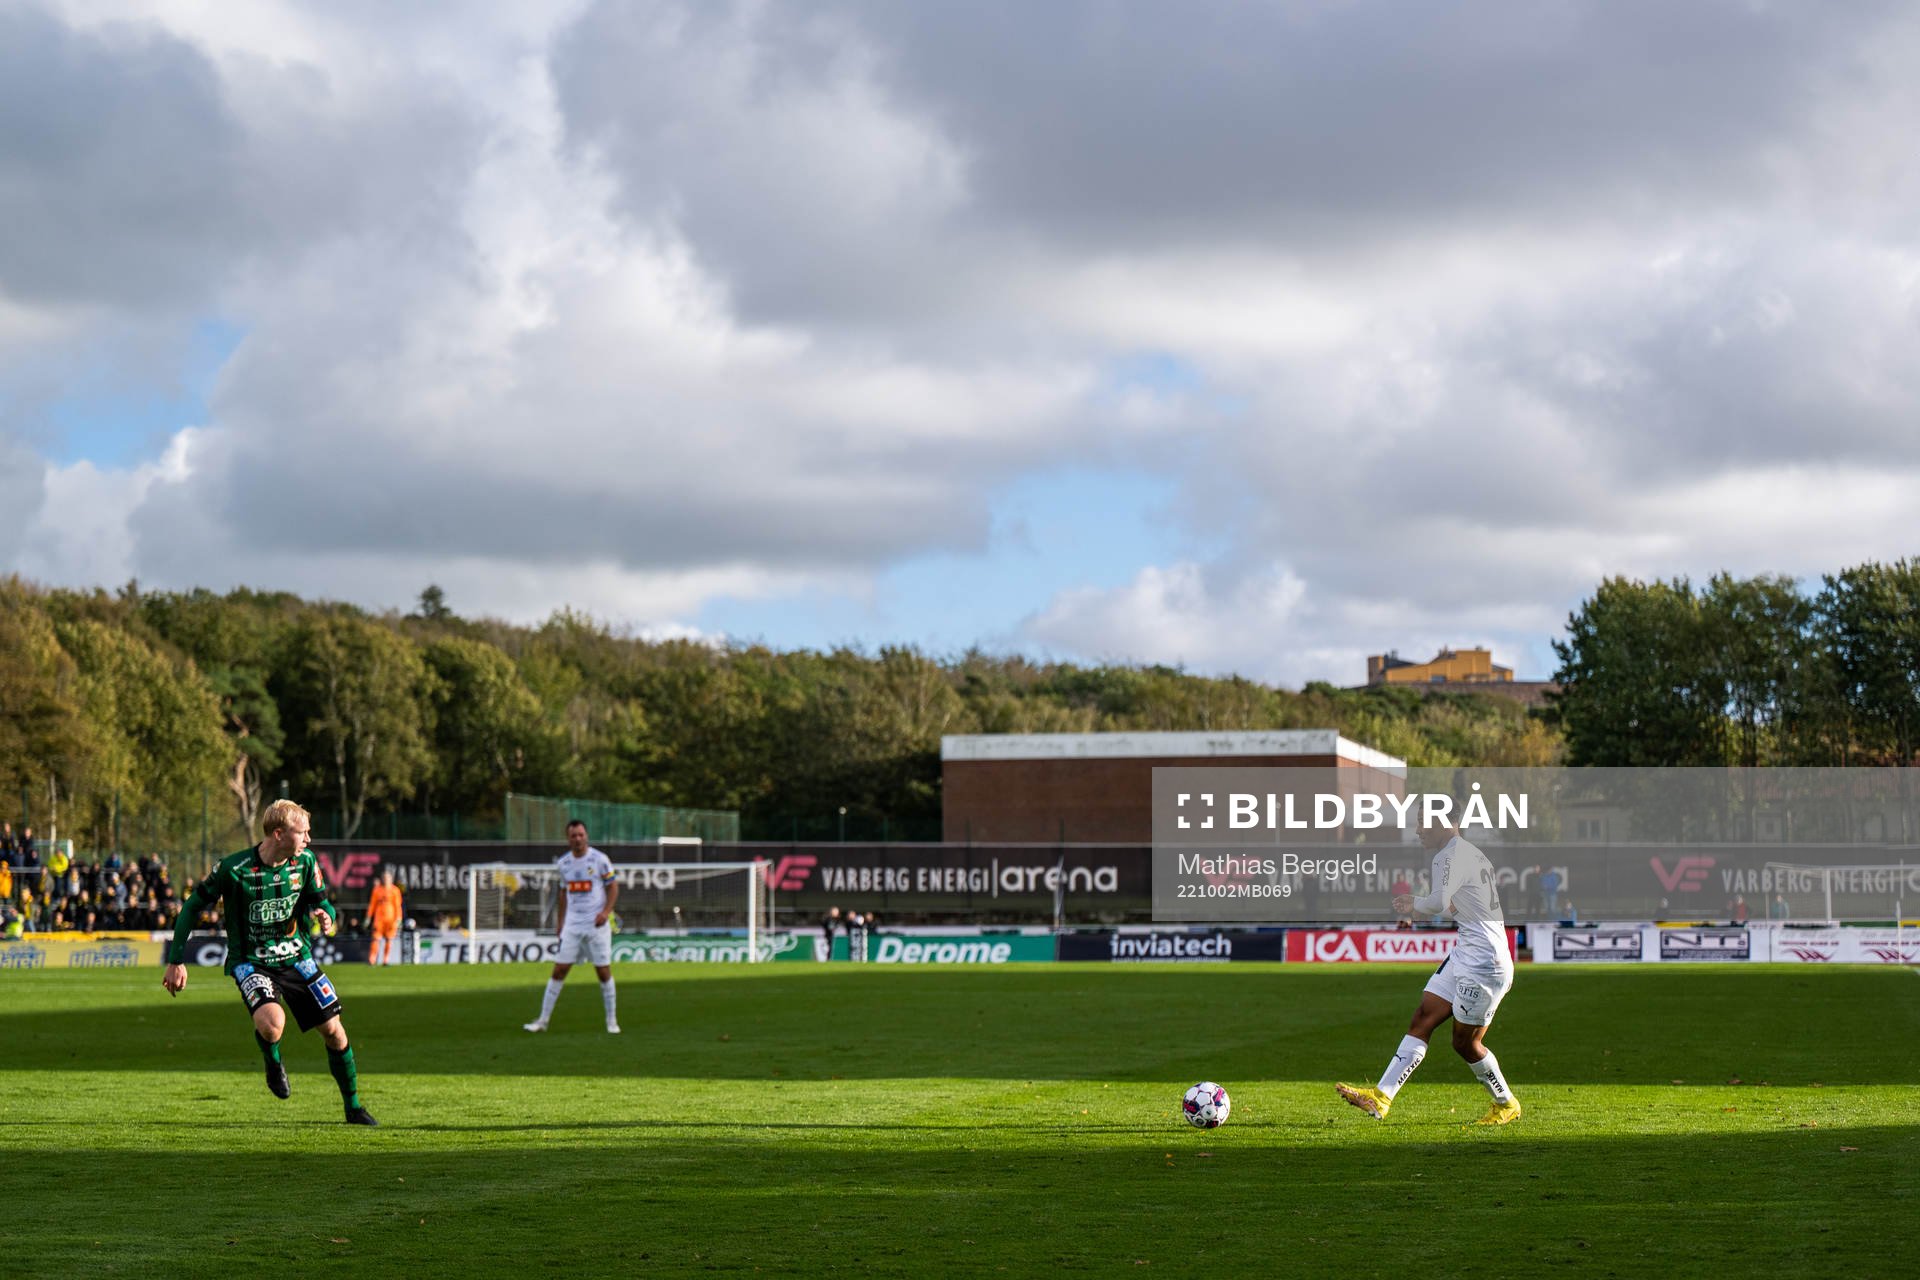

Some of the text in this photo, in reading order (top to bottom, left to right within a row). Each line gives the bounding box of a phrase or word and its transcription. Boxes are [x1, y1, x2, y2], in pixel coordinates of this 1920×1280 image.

[822, 866, 1118, 892] VARBERG ENERGI arena
[1722, 868, 1812, 893] VARBERG
[876, 937, 1011, 963] Derome
[1111, 934, 1232, 956] inviatech
[1305, 933, 1457, 962] ICA KVANT
